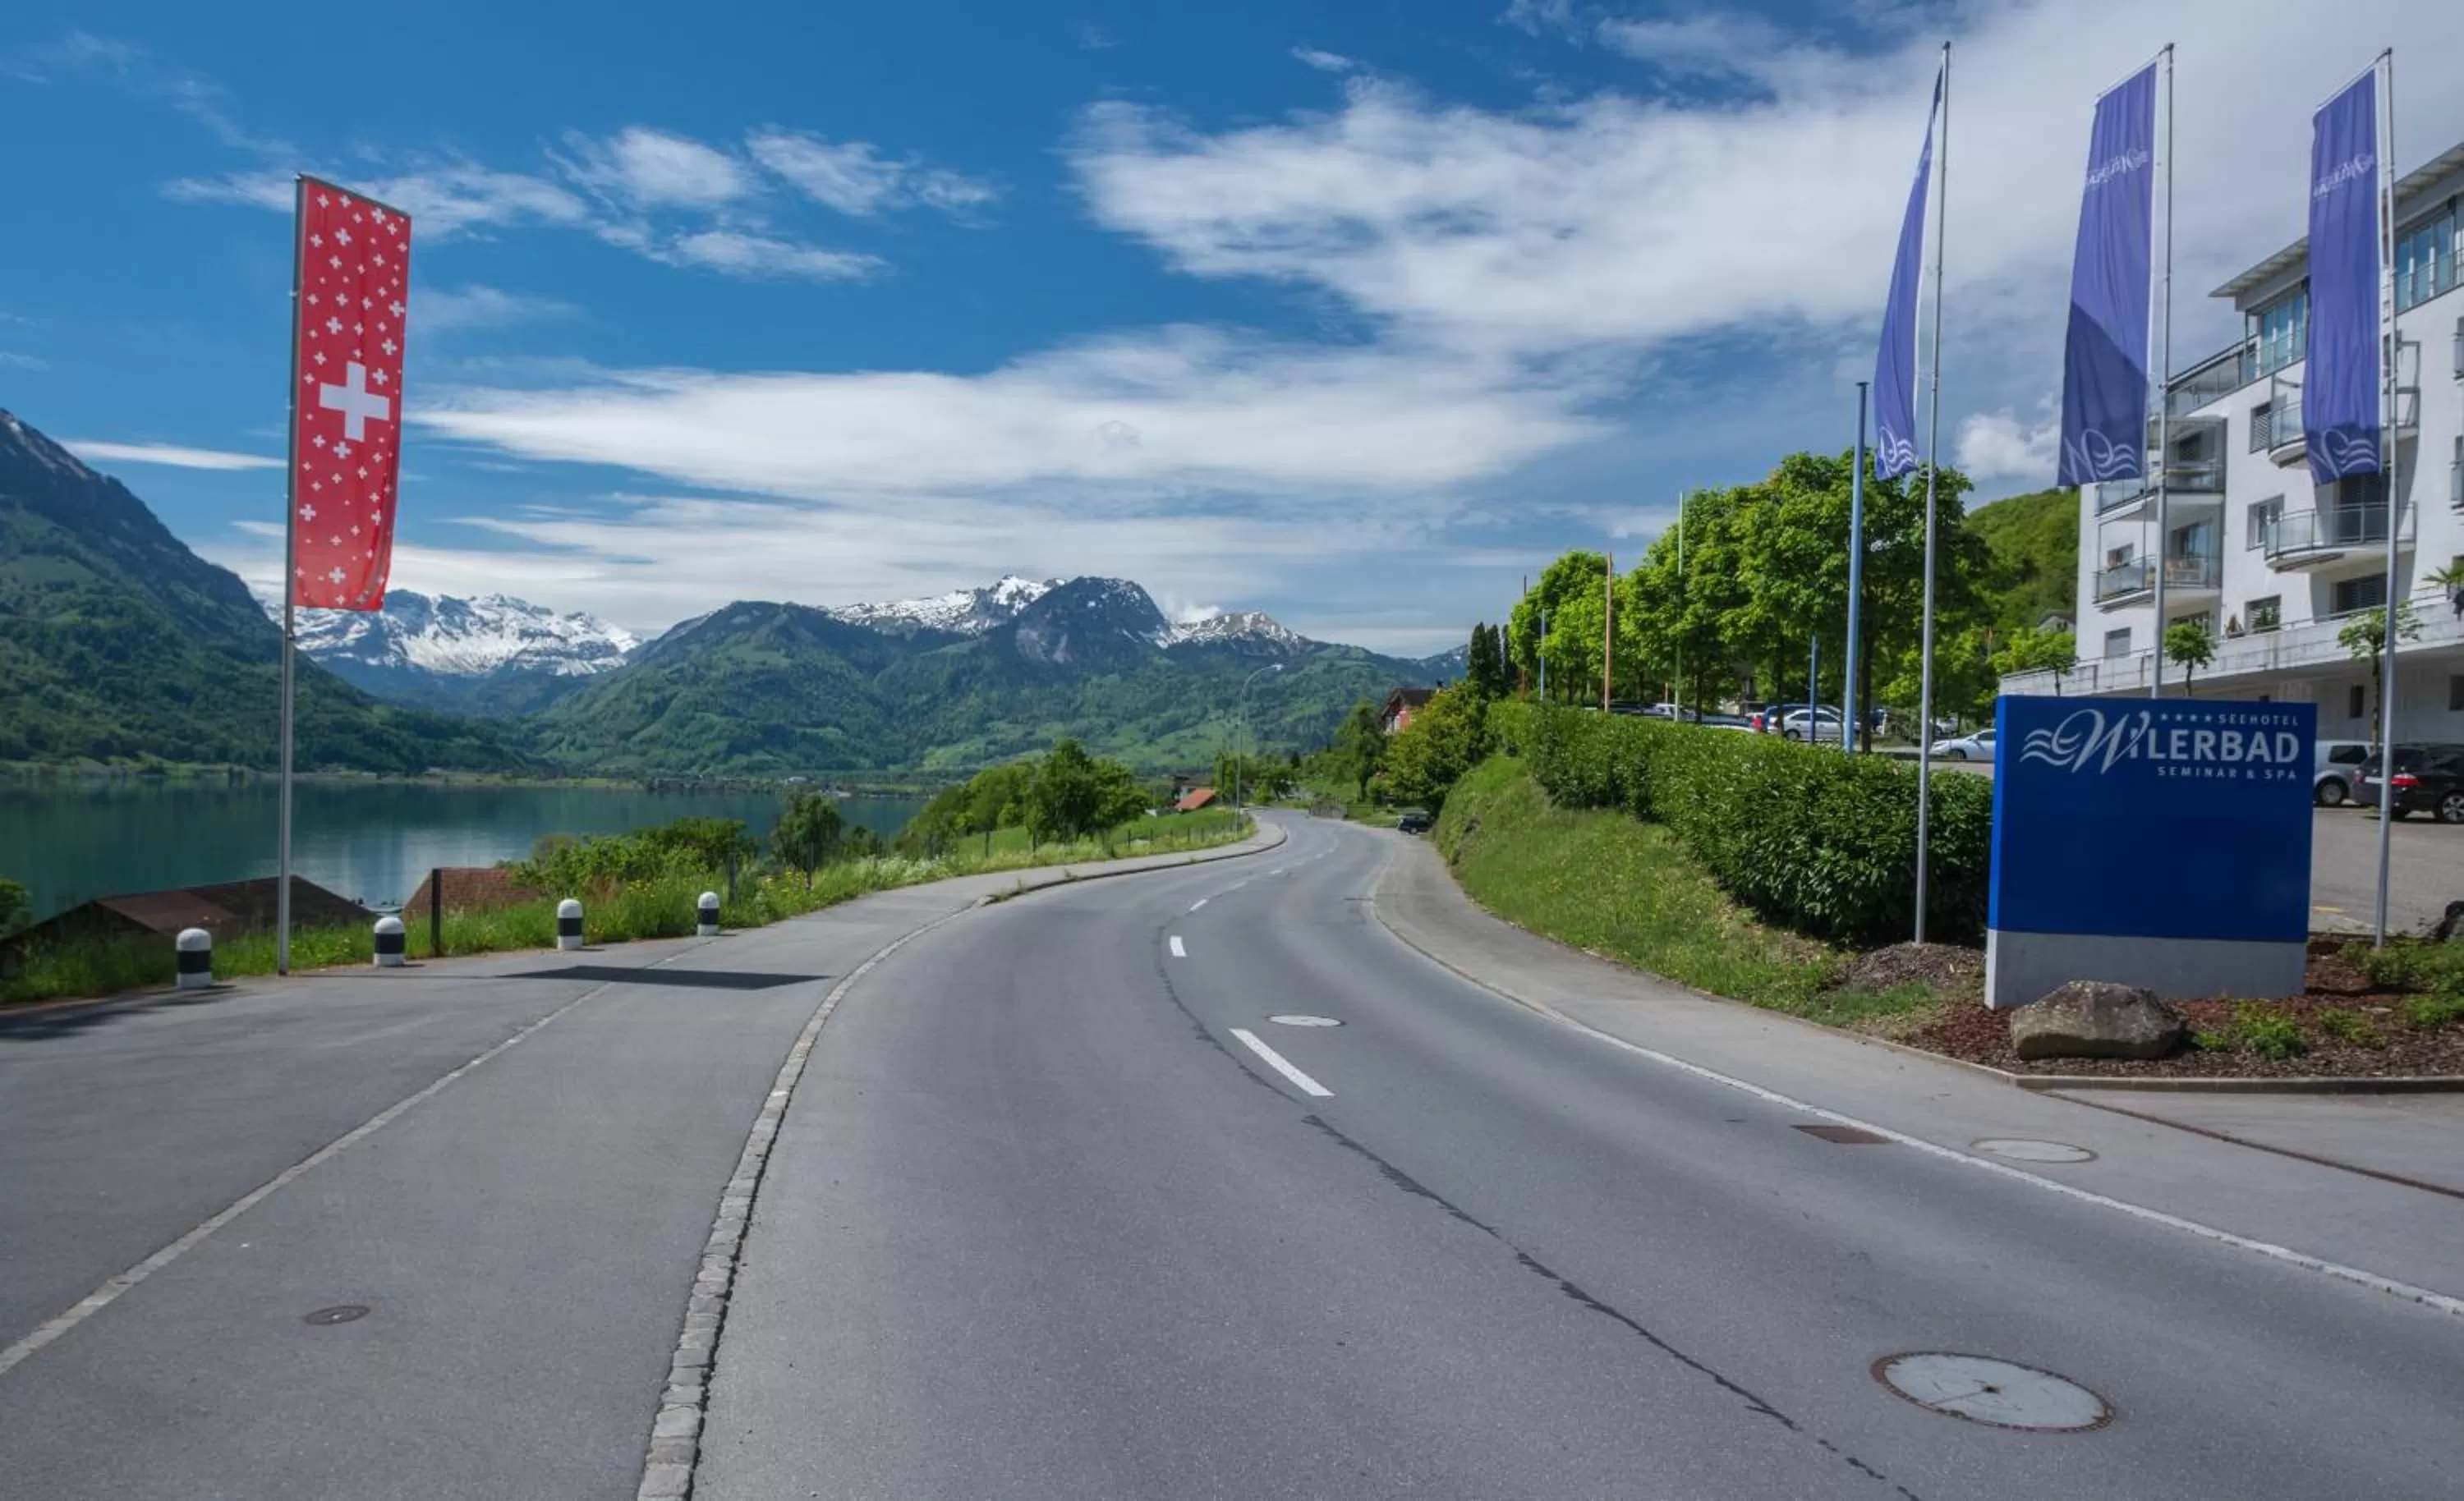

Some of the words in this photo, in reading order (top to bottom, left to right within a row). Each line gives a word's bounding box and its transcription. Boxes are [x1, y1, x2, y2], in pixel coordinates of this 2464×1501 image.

[2218, 713, 2299, 727] SEEHOTEL
[2051, 709, 2300, 776] WILERBAD
[2157, 766, 2237, 779] SEMINAR
[2246, 768, 2256, 780] &
[2264, 768, 2297, 781] SPA
